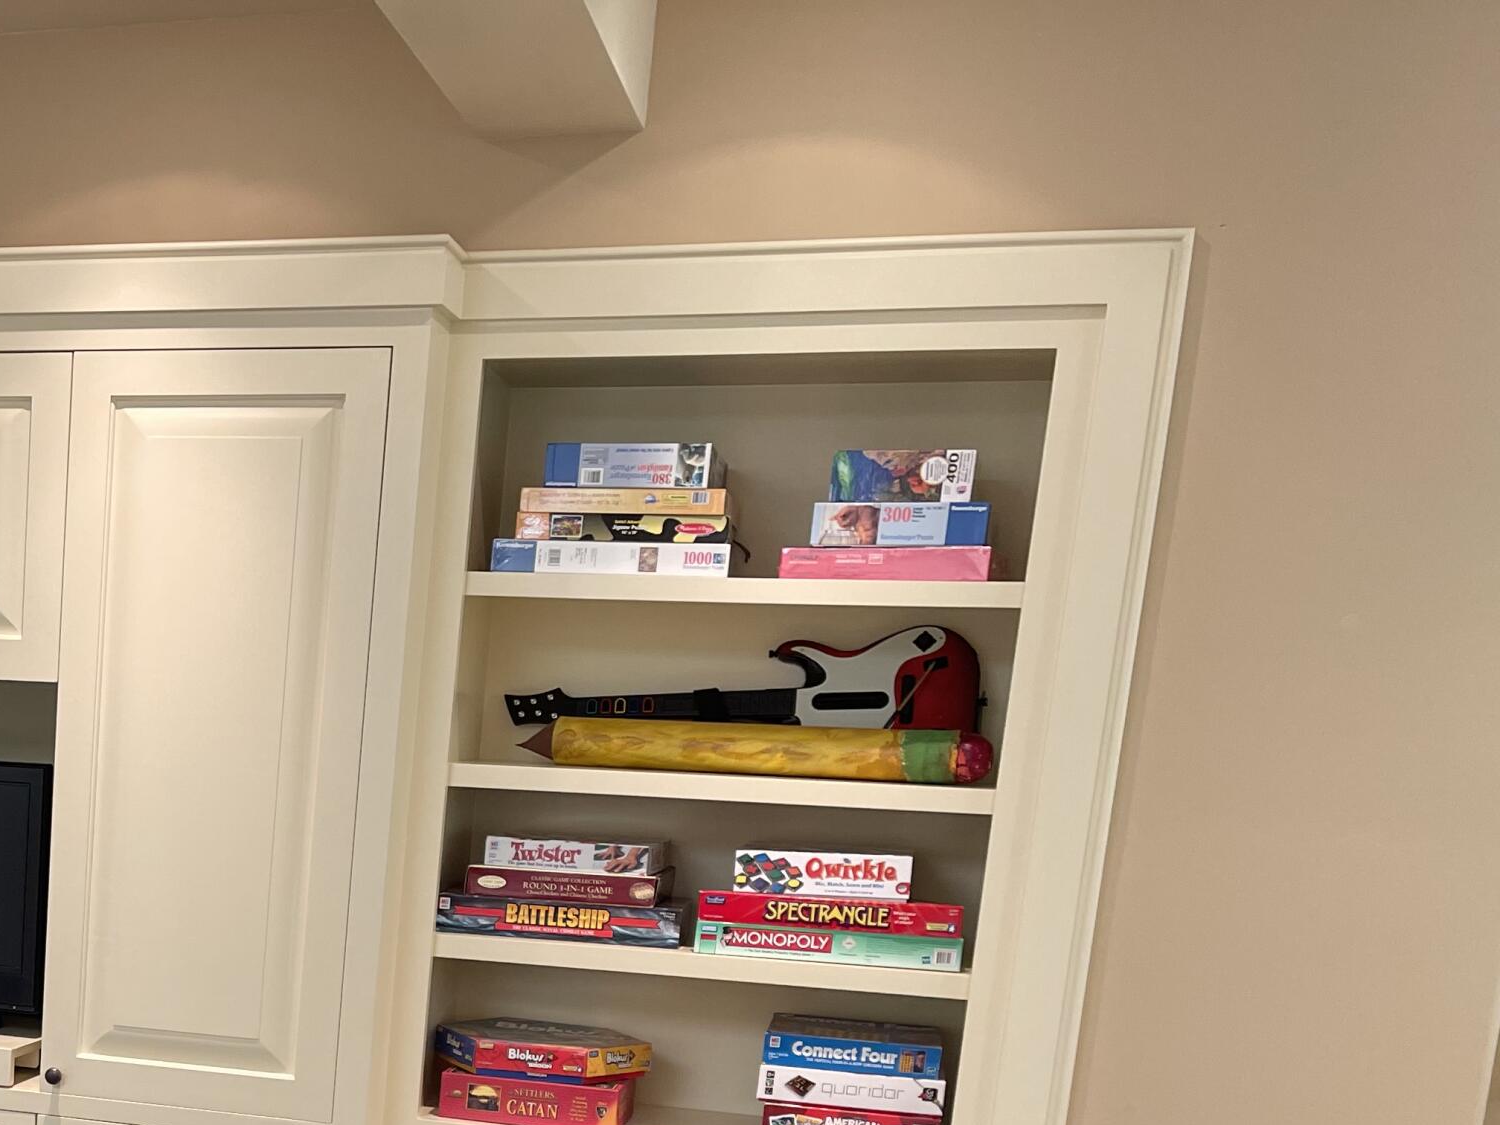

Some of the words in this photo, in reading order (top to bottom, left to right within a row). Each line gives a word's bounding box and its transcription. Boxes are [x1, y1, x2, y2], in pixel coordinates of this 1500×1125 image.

[946, 453, 959, 483] 400
[883, 507, 912, 522] 300
[683, 551, 713, 565] 1000
[511, 841, 581, 864] Twister
[805, 857, 898, 882] Qwirkle
[523, 881, 557, 891] ROUND
[587, 885, 614, 895] GAME
[506, 903, 610, 929] BATTLESHIP
[765, 901, 889, 927] SPECTRANGLE
[732, 930, 829, 950] MONOPOLY
[508, 1048, 544, 1062] Blokus
[792, 1040, 857, 1062] Connect
[861, 1047, 900, 1065] Four
[515, 1088, 555, 1098] SETTLERS
[821, 1082, 905, 1100] quoridor
[506, 1099, 558, 1119] CATAN
